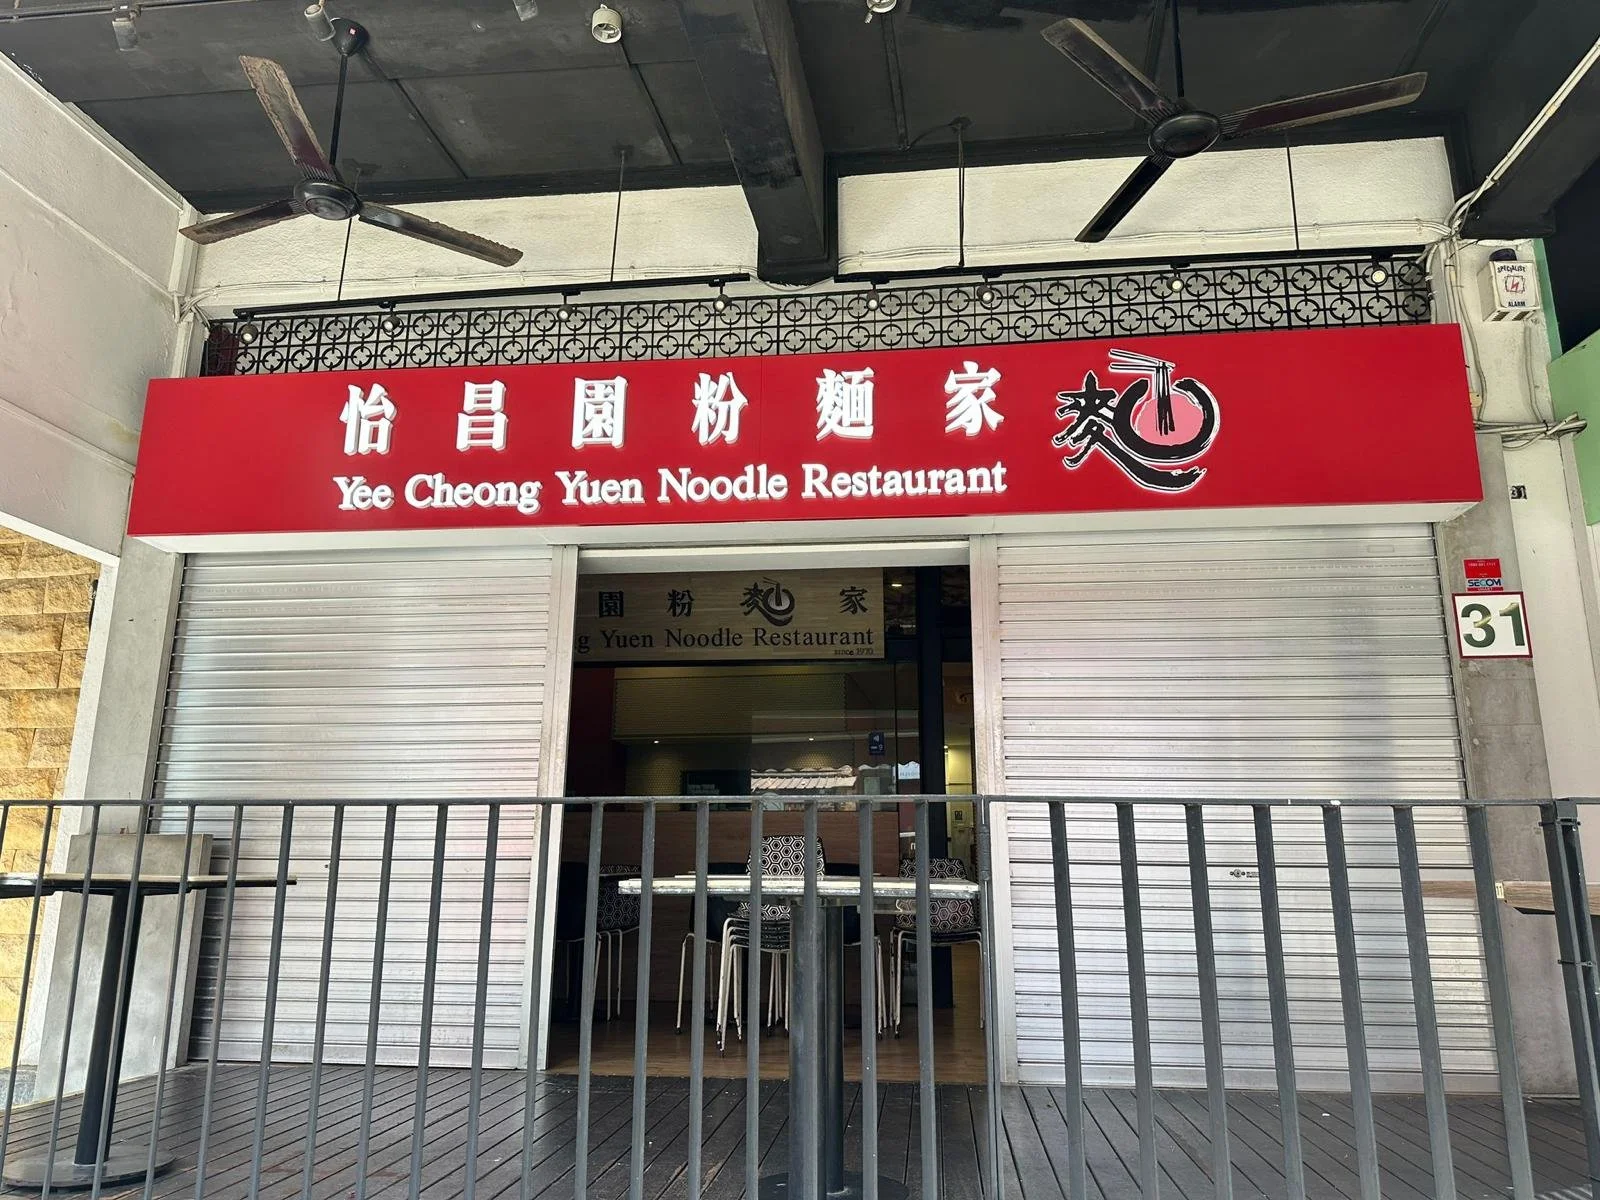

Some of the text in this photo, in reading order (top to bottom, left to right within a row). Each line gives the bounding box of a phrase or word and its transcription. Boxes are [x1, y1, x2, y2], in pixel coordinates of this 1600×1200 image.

[1497, 264, 1526, 273] SPECIALIST
[333, 461, 1008, 515] Yee Cheong Yuen Noodle Restaurant
[1467, 578, 1502, 587] SECOM
[1461, 602, 1526, 648] 31
[601, 628, 654, 648] Yuen
[664, 626, 743, 648] Noodle
[752, 626, 874, 647] Restaurant
